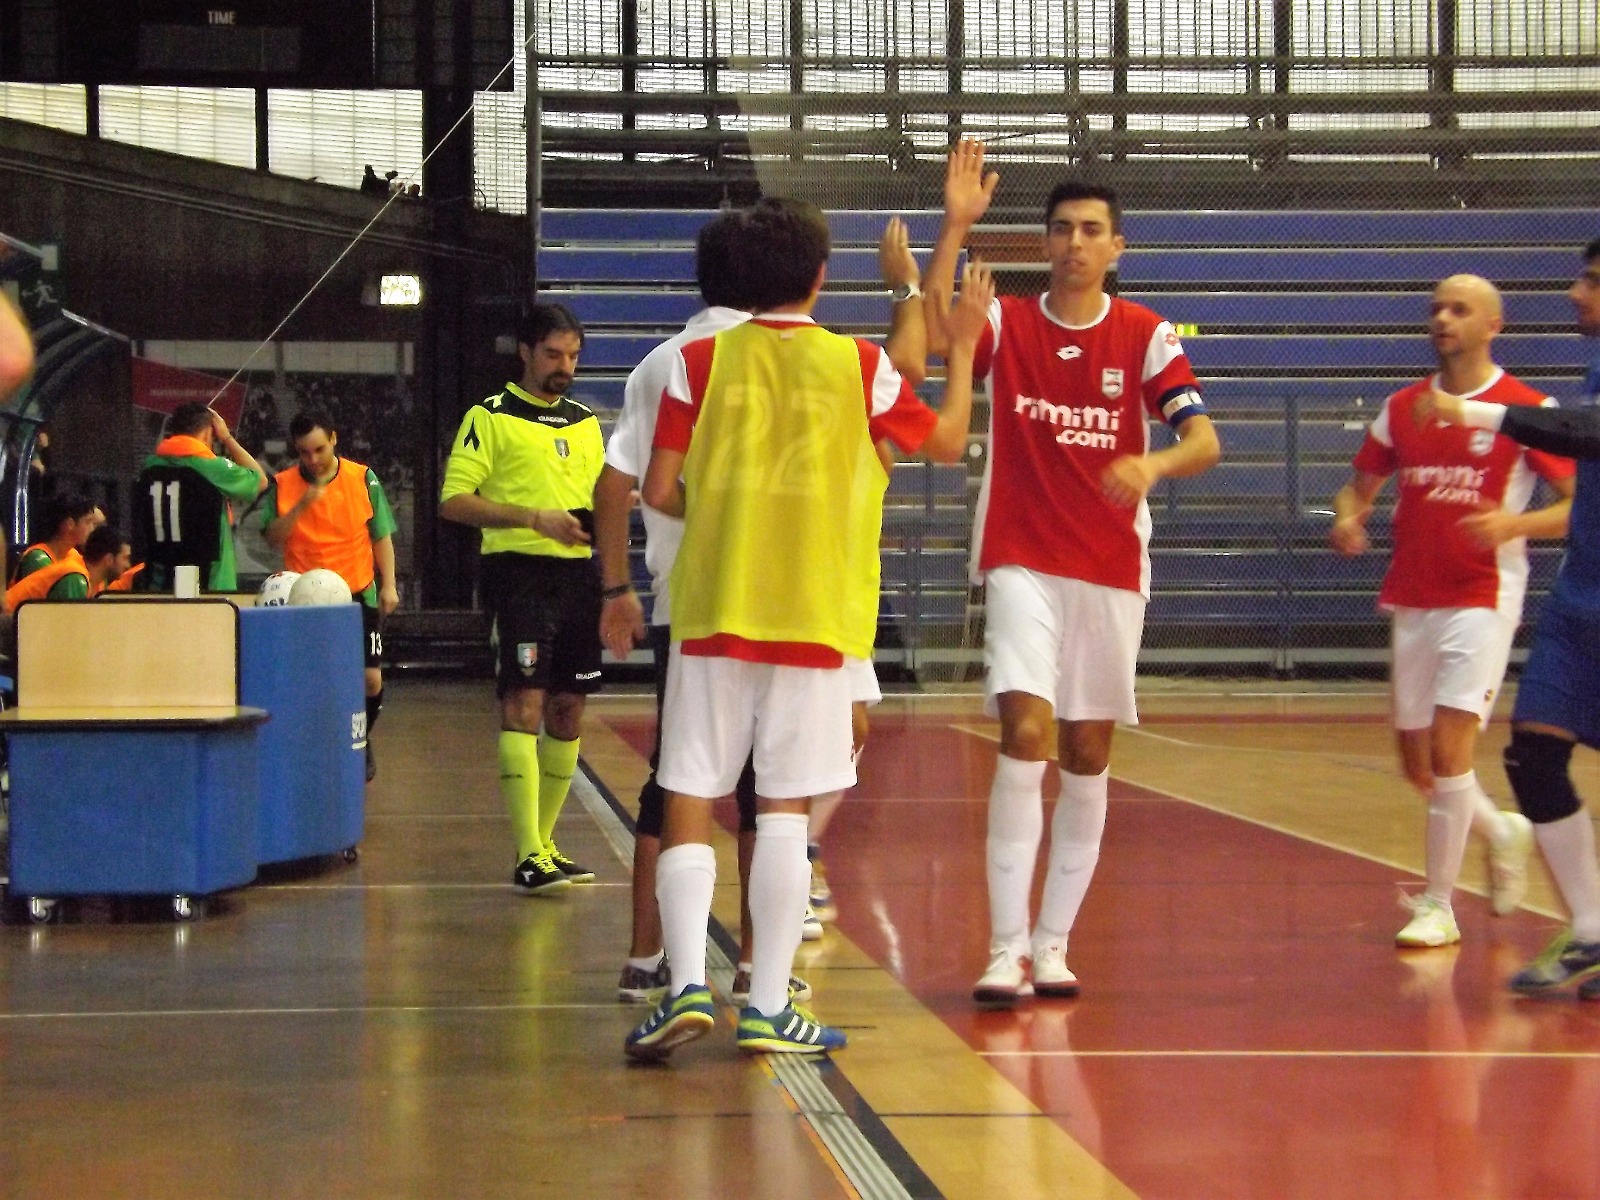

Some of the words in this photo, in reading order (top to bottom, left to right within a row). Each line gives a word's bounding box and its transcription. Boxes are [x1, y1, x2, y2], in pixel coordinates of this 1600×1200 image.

[207, 10, 236, 24] TIME
[1014, 393, 1123, 432] rimini
[149, 480, 182, 542] 11
[370, 630, 383, 656] 13
